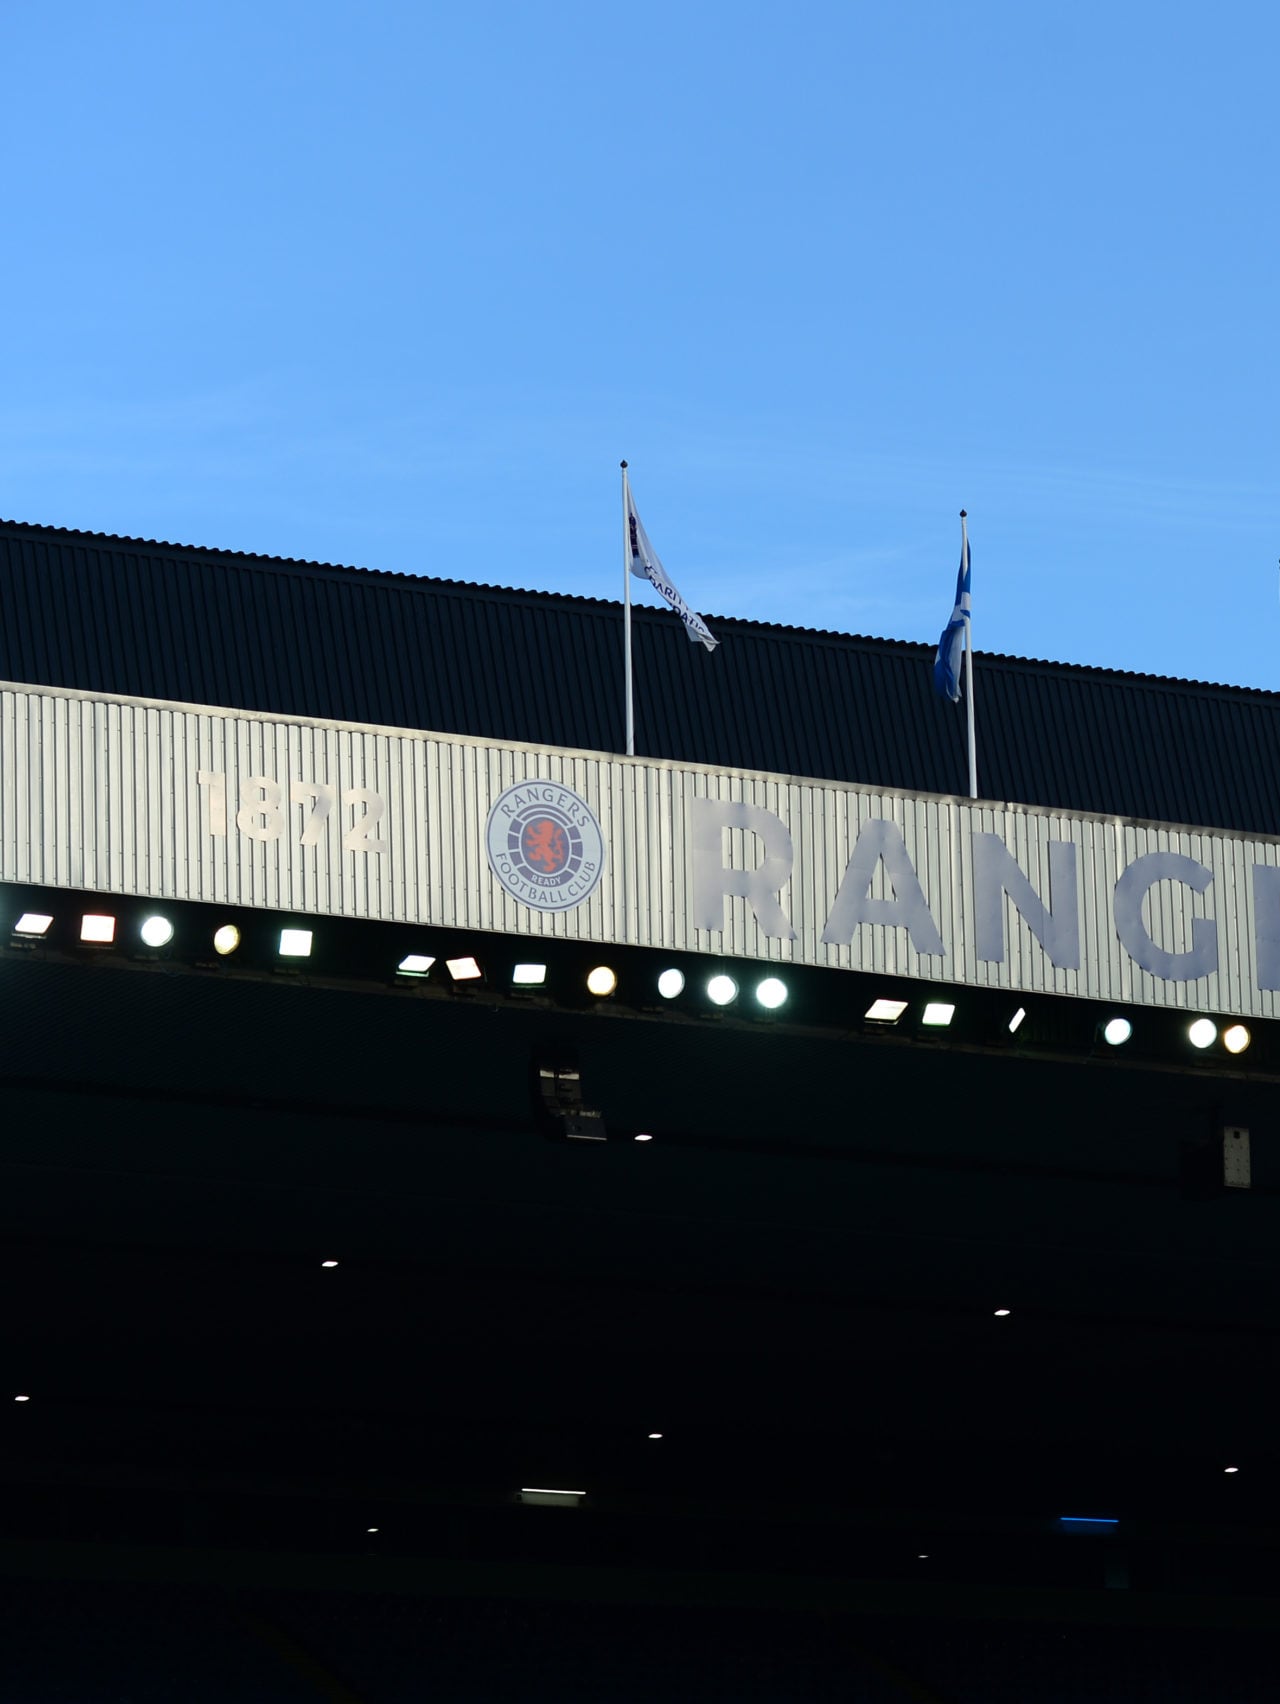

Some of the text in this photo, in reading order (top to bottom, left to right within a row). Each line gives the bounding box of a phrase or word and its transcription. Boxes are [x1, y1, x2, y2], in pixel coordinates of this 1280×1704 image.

[197, 770, 387, 853] 1872
[500, 788, 590, 828] RANGERS
[496, 852, 596, 903] FOOTBALL CLUB
[531, 875, 561, 886] READY
